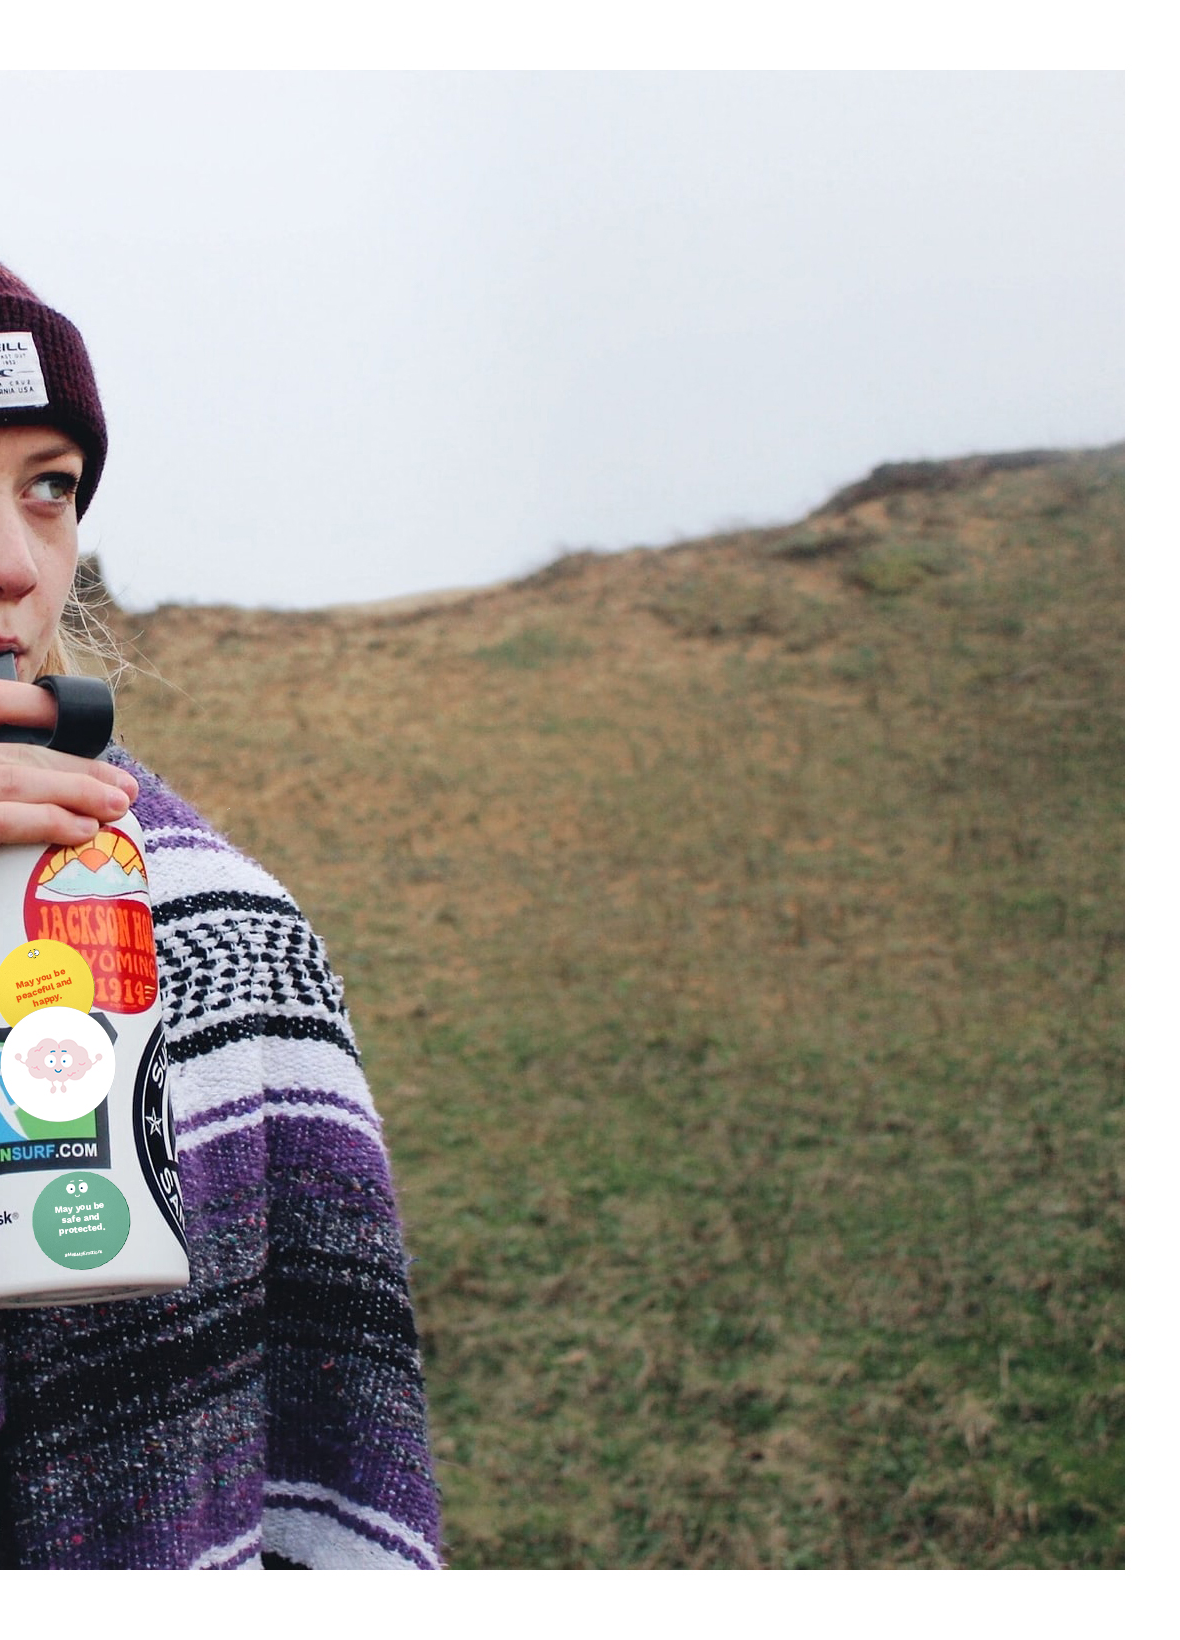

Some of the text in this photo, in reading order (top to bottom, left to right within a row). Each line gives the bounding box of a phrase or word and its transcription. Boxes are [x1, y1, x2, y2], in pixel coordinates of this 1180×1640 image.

[38, 904, 131, 948] JACKSON
[80, 949, 156, 980] YOMING
[15, 968, 66, 990] May you be
[15, 976, 73, 1004] peaceful and
[32, 993, 63, 1008] happy.
[95, 977, 145, 1006] 1914
[54, 1201, 105, 1215] May you be
[61, 1212, 100, 1224] safe and
[58, 1222, 106, 1237] protected.
